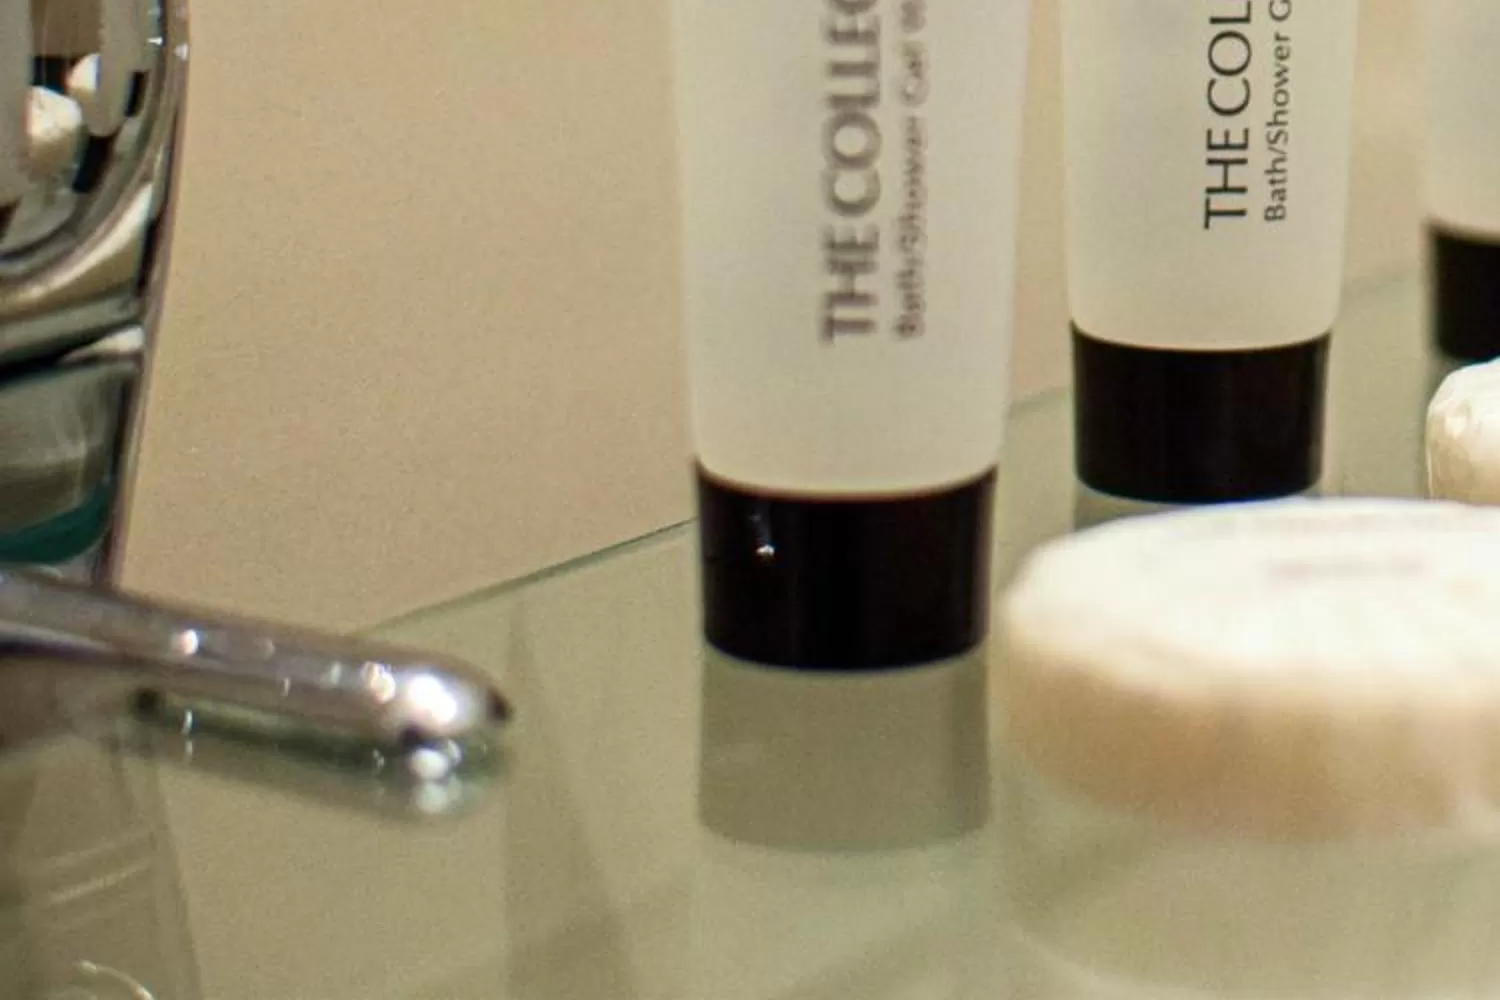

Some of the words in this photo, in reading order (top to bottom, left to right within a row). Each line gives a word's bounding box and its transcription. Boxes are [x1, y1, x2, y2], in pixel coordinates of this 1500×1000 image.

[893, 41, 928, 107] Gel
[1263, 32, 1292, 222] Bath/Shower
[892, 116, 928, 342] Bath/Shower
[1203, 128, 1249, 230] THE
[820, 226, 881, 344] THE
